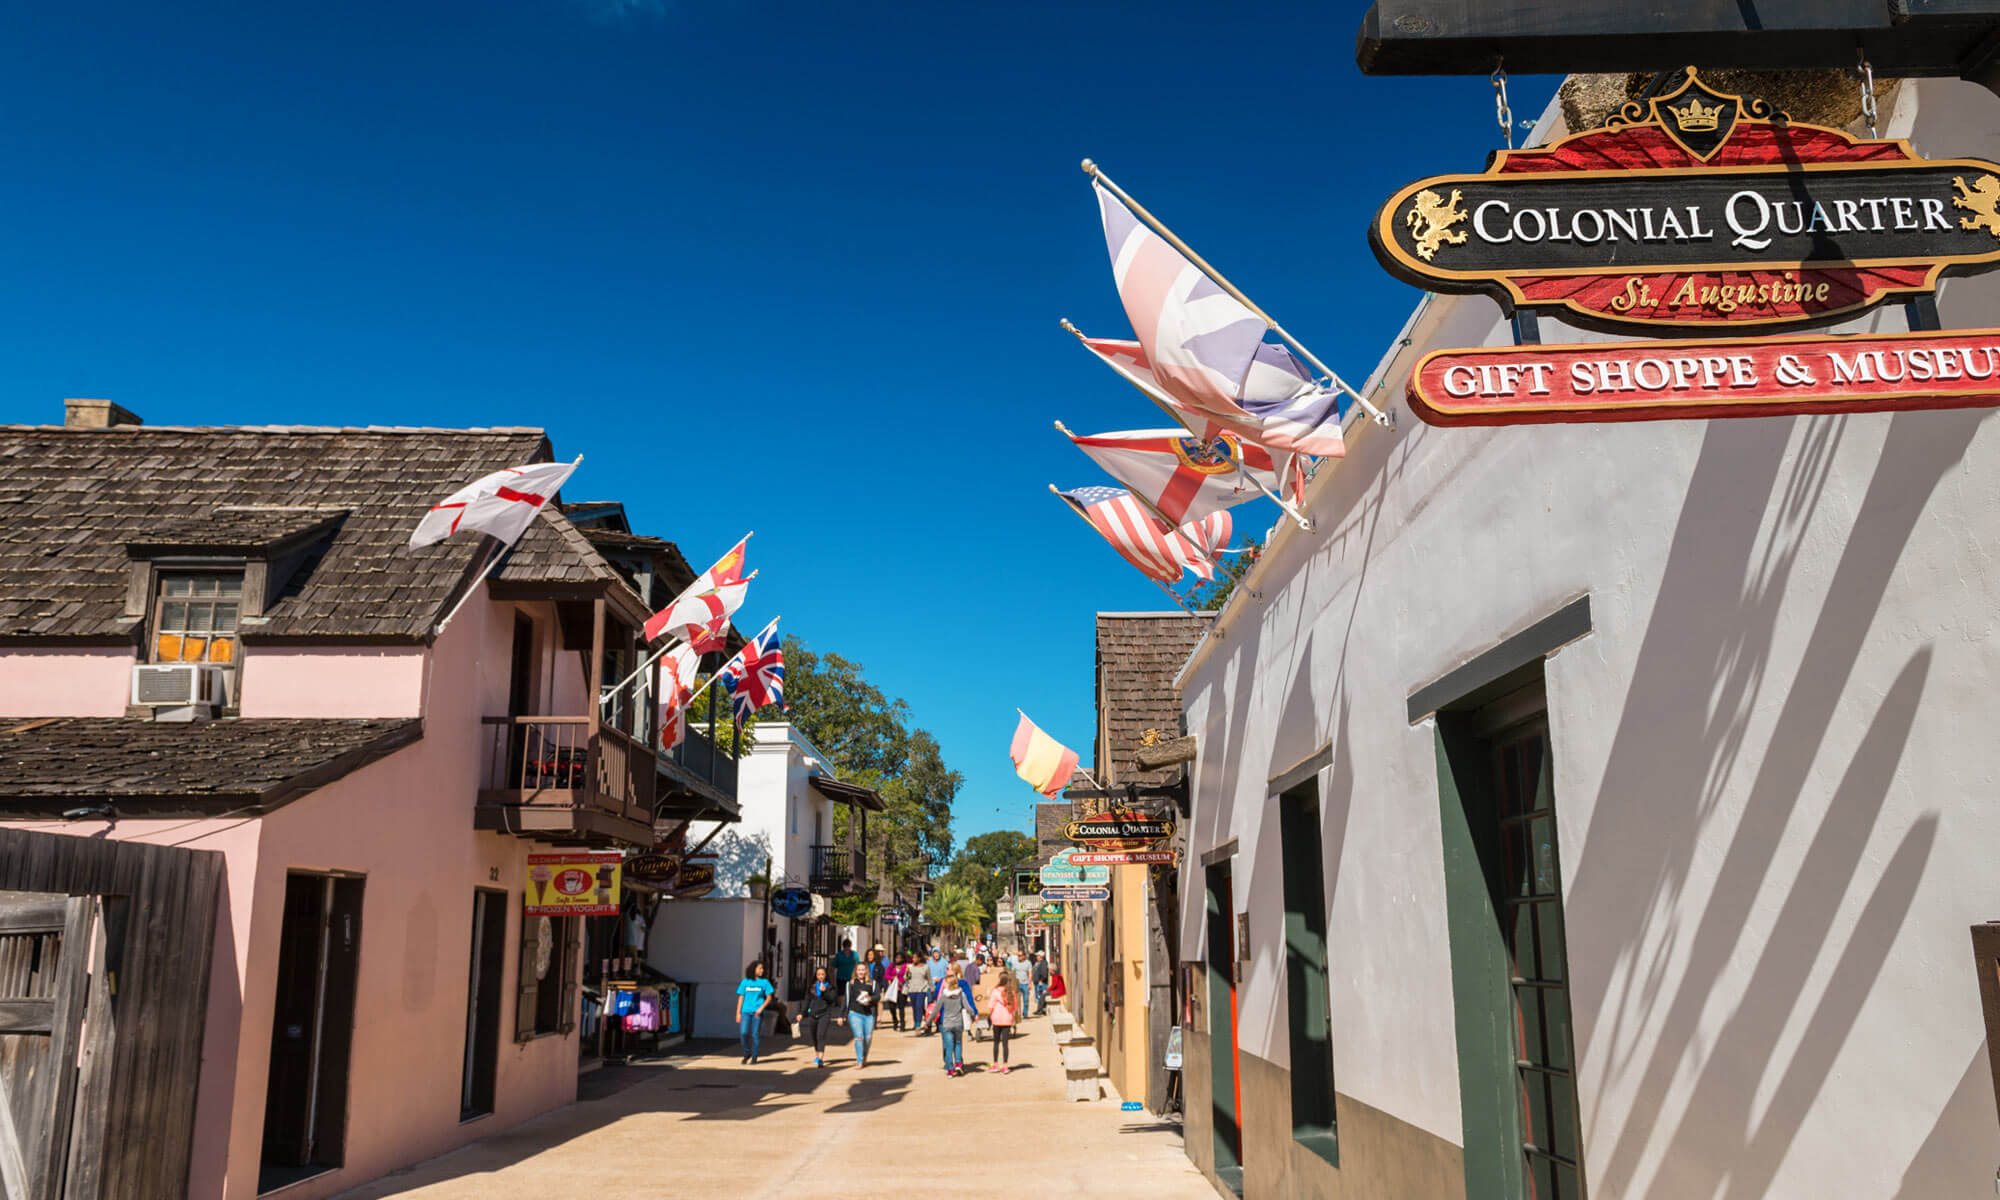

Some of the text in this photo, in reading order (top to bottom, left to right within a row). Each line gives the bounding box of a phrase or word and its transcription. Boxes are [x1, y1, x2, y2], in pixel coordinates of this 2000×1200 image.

[1472, 190, 1953, 250] COLONIAL QUARTER
[1611, 272, 1830, 313] St. Augustine
[1443, 346, 2000, 398] GIFT SHOPPE & MUSEU
[1080, 824, 1160, 836] COLONIAL QUARTER
[534, 905, 570, 913] FROZEN
